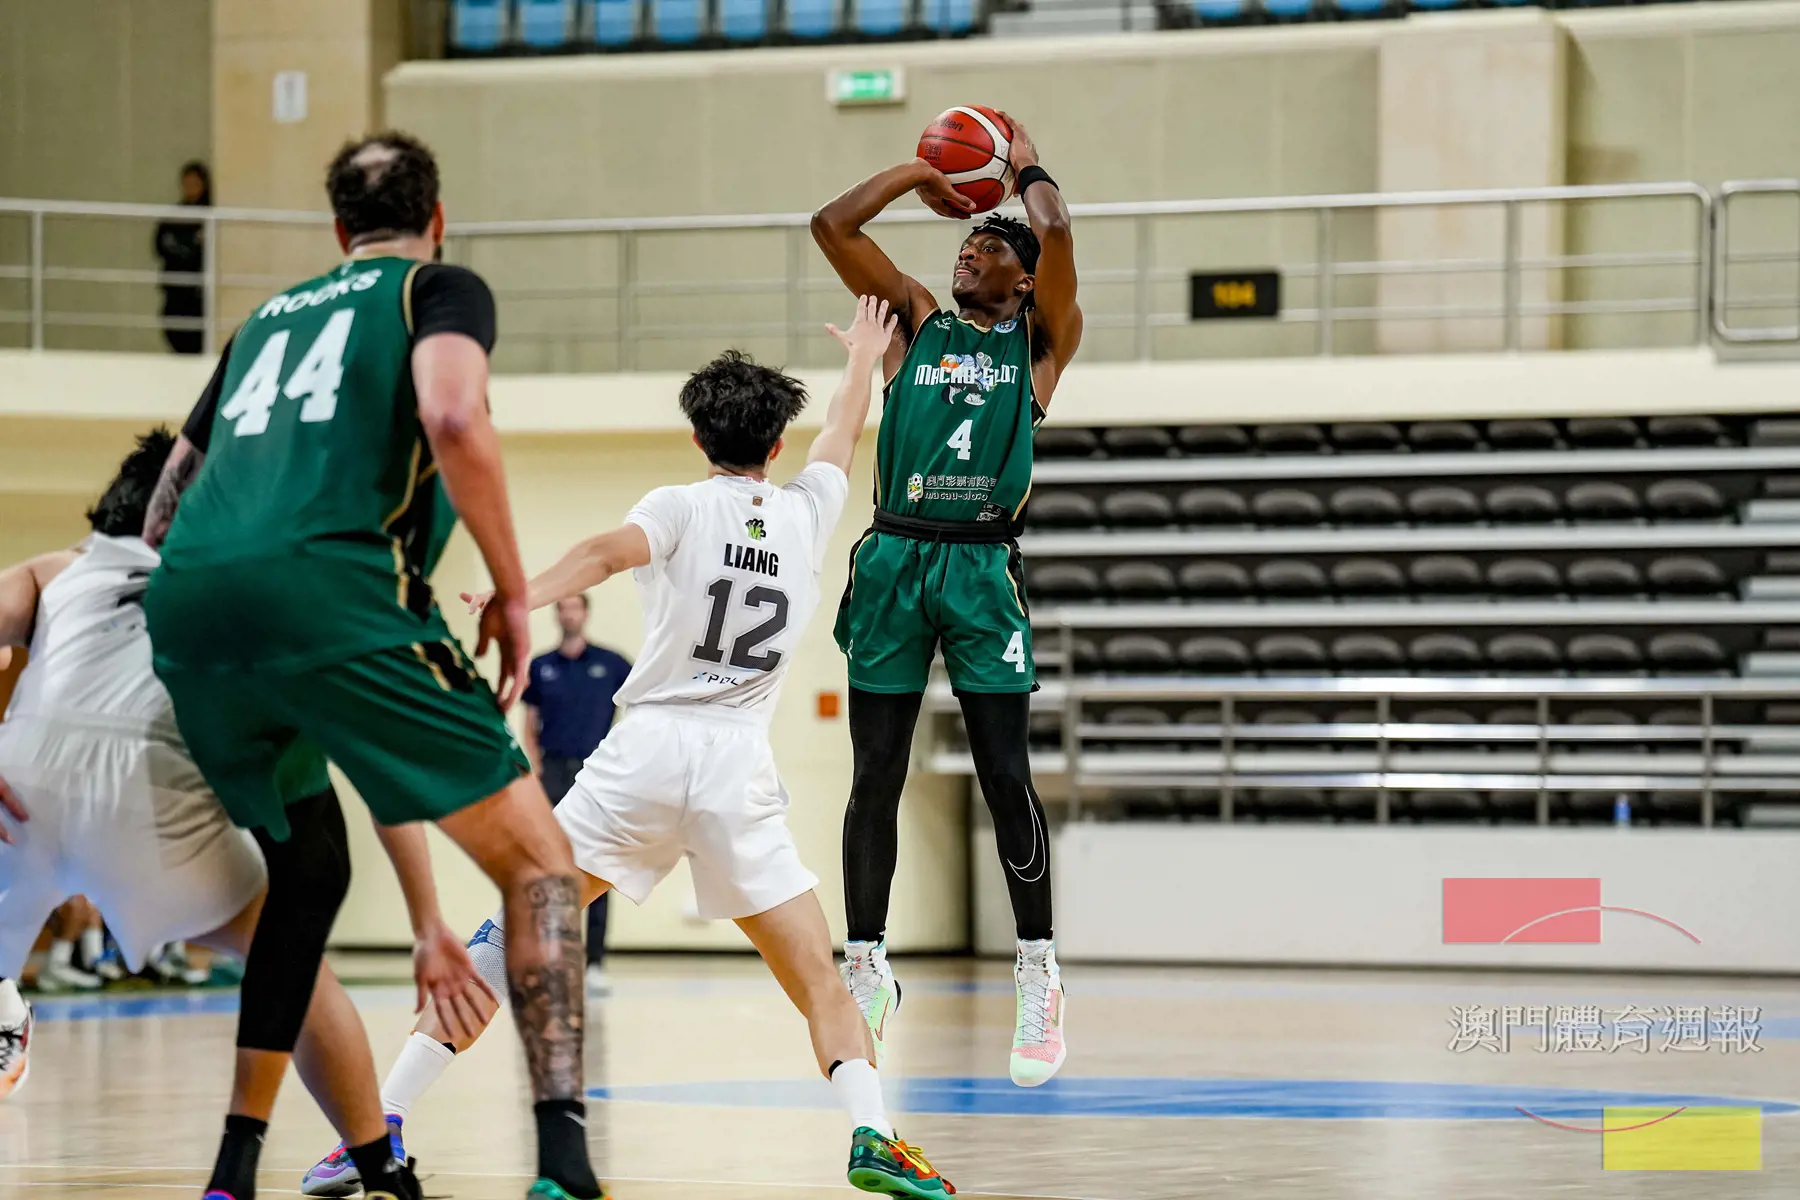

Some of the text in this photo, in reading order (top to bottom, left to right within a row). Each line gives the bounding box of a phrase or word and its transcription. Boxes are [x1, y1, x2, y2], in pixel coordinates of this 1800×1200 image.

[258, 268, 383, 320] ROCKS
[220, 306, 356, 437] 44
[946, 419, 973, 461] 4
[723, 543, 779, 577] LIANG
[690, 577, 790, 673] 12
[1001, 631, 1025, 673] 4
